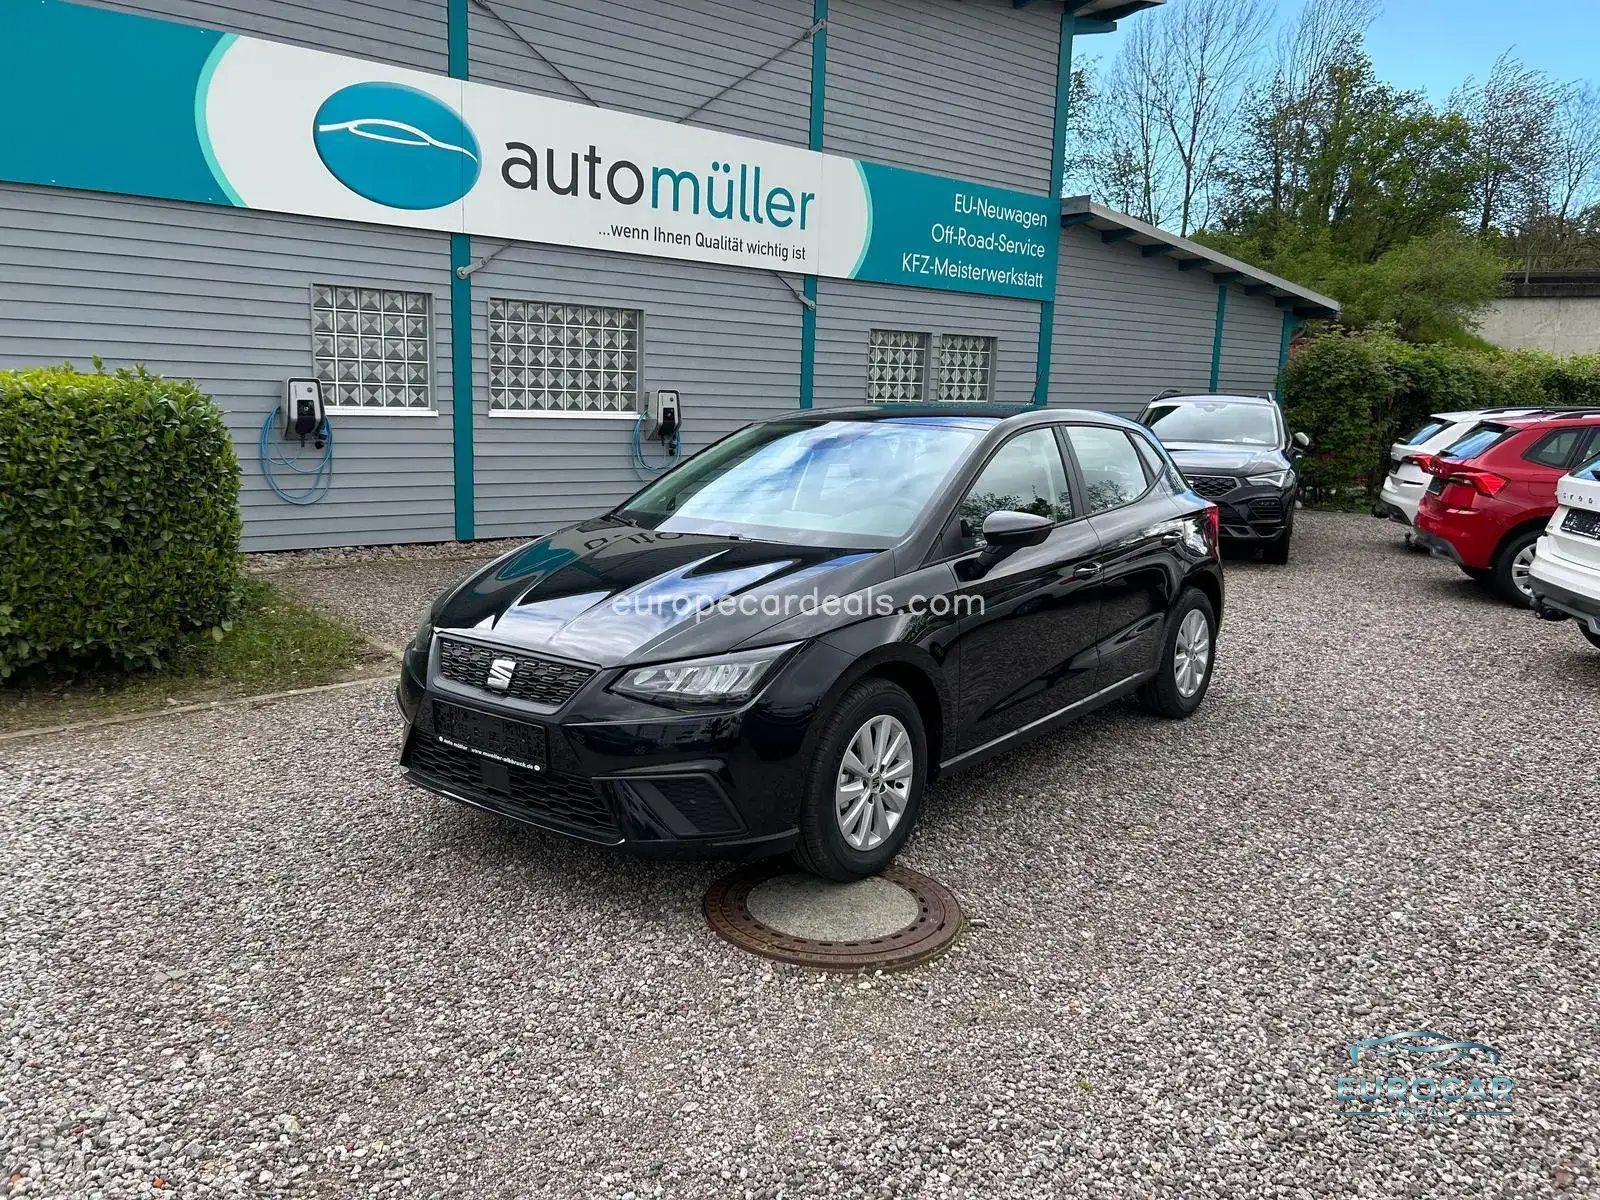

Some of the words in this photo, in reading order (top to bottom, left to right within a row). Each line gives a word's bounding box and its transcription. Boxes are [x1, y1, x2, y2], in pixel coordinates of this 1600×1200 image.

[954, 193, 1048, 228] EU-Neuwagen
[598, 224, 649, 241] ...wenn
[653, 226, 691, 246] Ihnen
[695, 232, 744, 253] Qualität
[746, 239, 789, 262] wichtig
[792, 244, 806, 260] ist
[931, 223, 1046, 258] Off-Road-Service
[902, 252, 1044, 288] KFZ-Meisterwerkstatt
